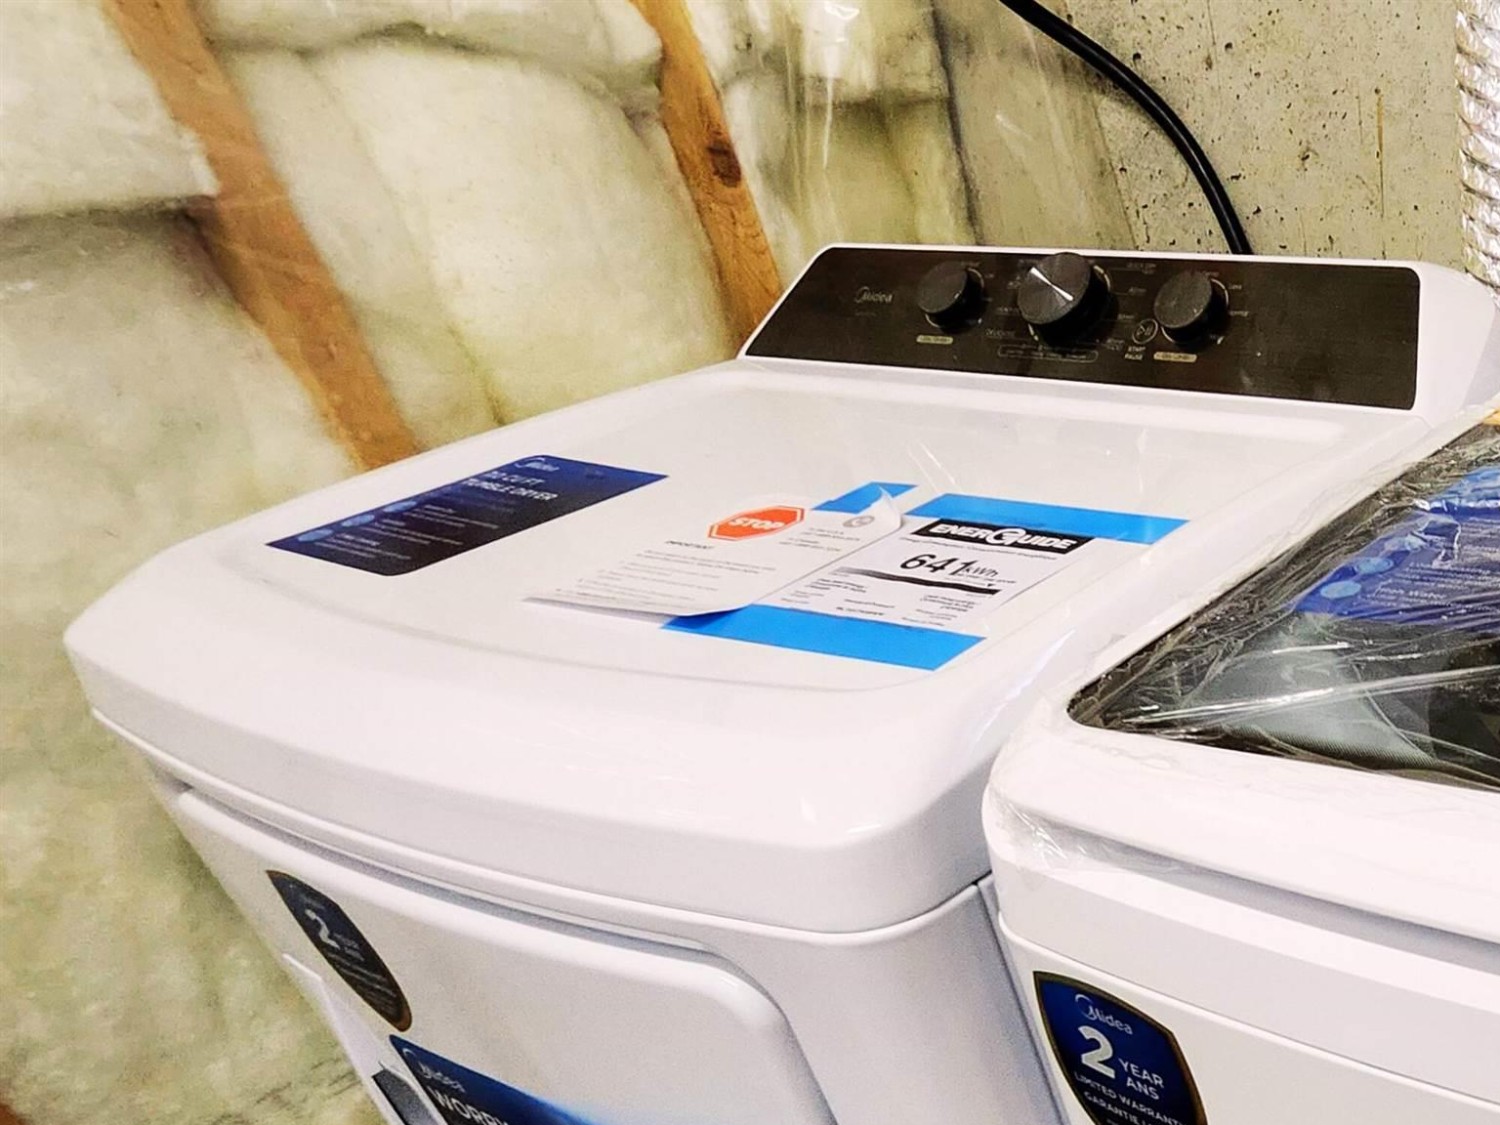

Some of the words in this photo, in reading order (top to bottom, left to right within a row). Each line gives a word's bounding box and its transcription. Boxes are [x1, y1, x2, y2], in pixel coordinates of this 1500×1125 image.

[728, 516, 787, 532] STOP
[929, 523, 1078, 549] ENERGUIDE
[900, 553, 978, 576] 641
[963, 566, 1000, 578] kWh
[1075, 993, 1134, 1035] Midea
[1078, 1025, 1116, 1080] 2
[1118, 1057, 1165, 1089] YEAR
[1074, 1071, 1118, 1100] LIMITED
[1126, 1076, 1160, 1101] ANS
[1083, 1091, 1141, 1125] GARANTIE
